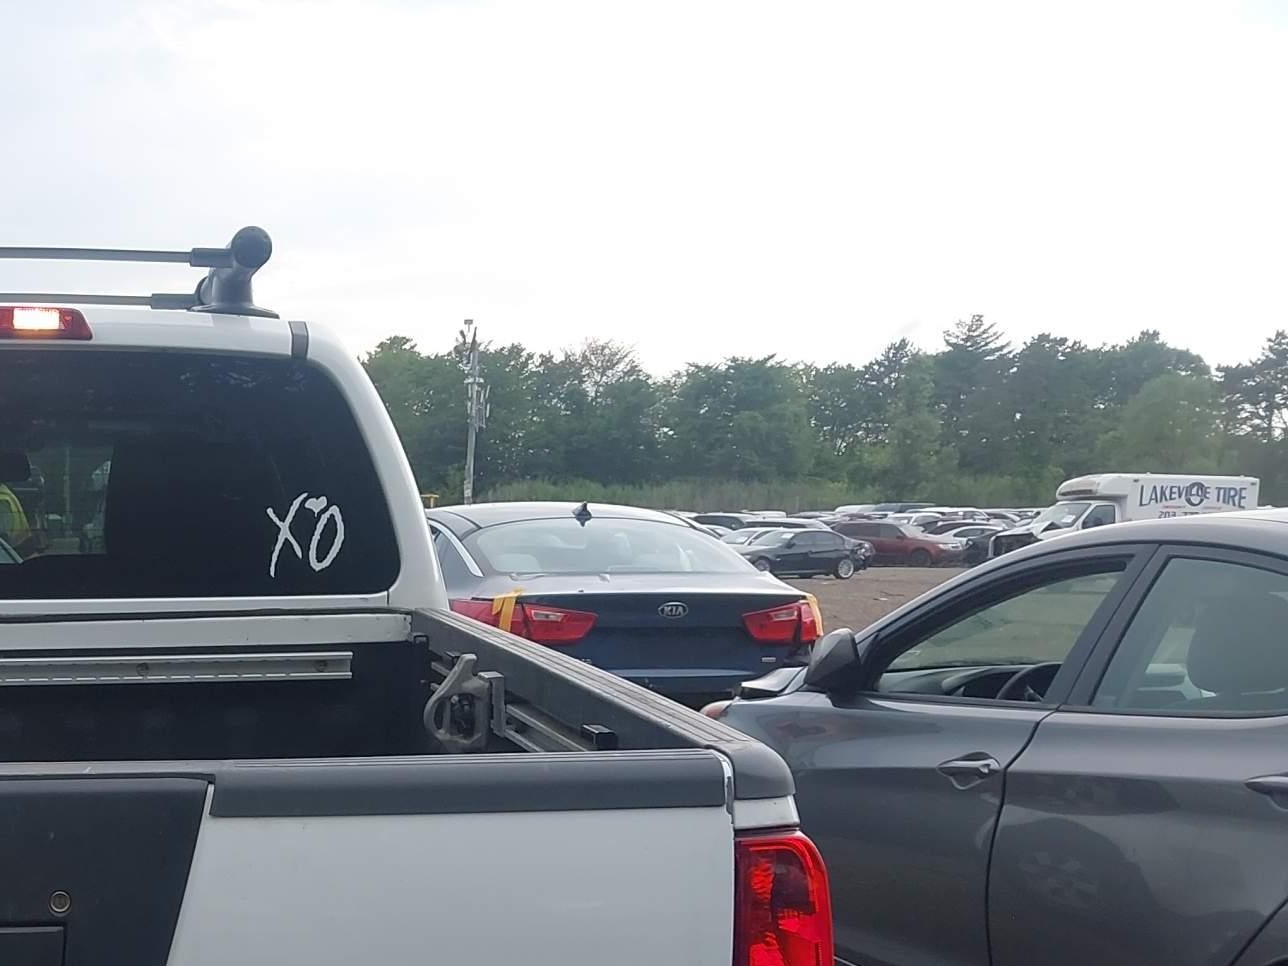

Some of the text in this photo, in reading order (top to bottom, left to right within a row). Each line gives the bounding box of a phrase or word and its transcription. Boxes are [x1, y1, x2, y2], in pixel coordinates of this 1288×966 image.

[1139, 485, 1248, 509] LAKEVILLE TIRE
[266, 492, 345, 578] XO
